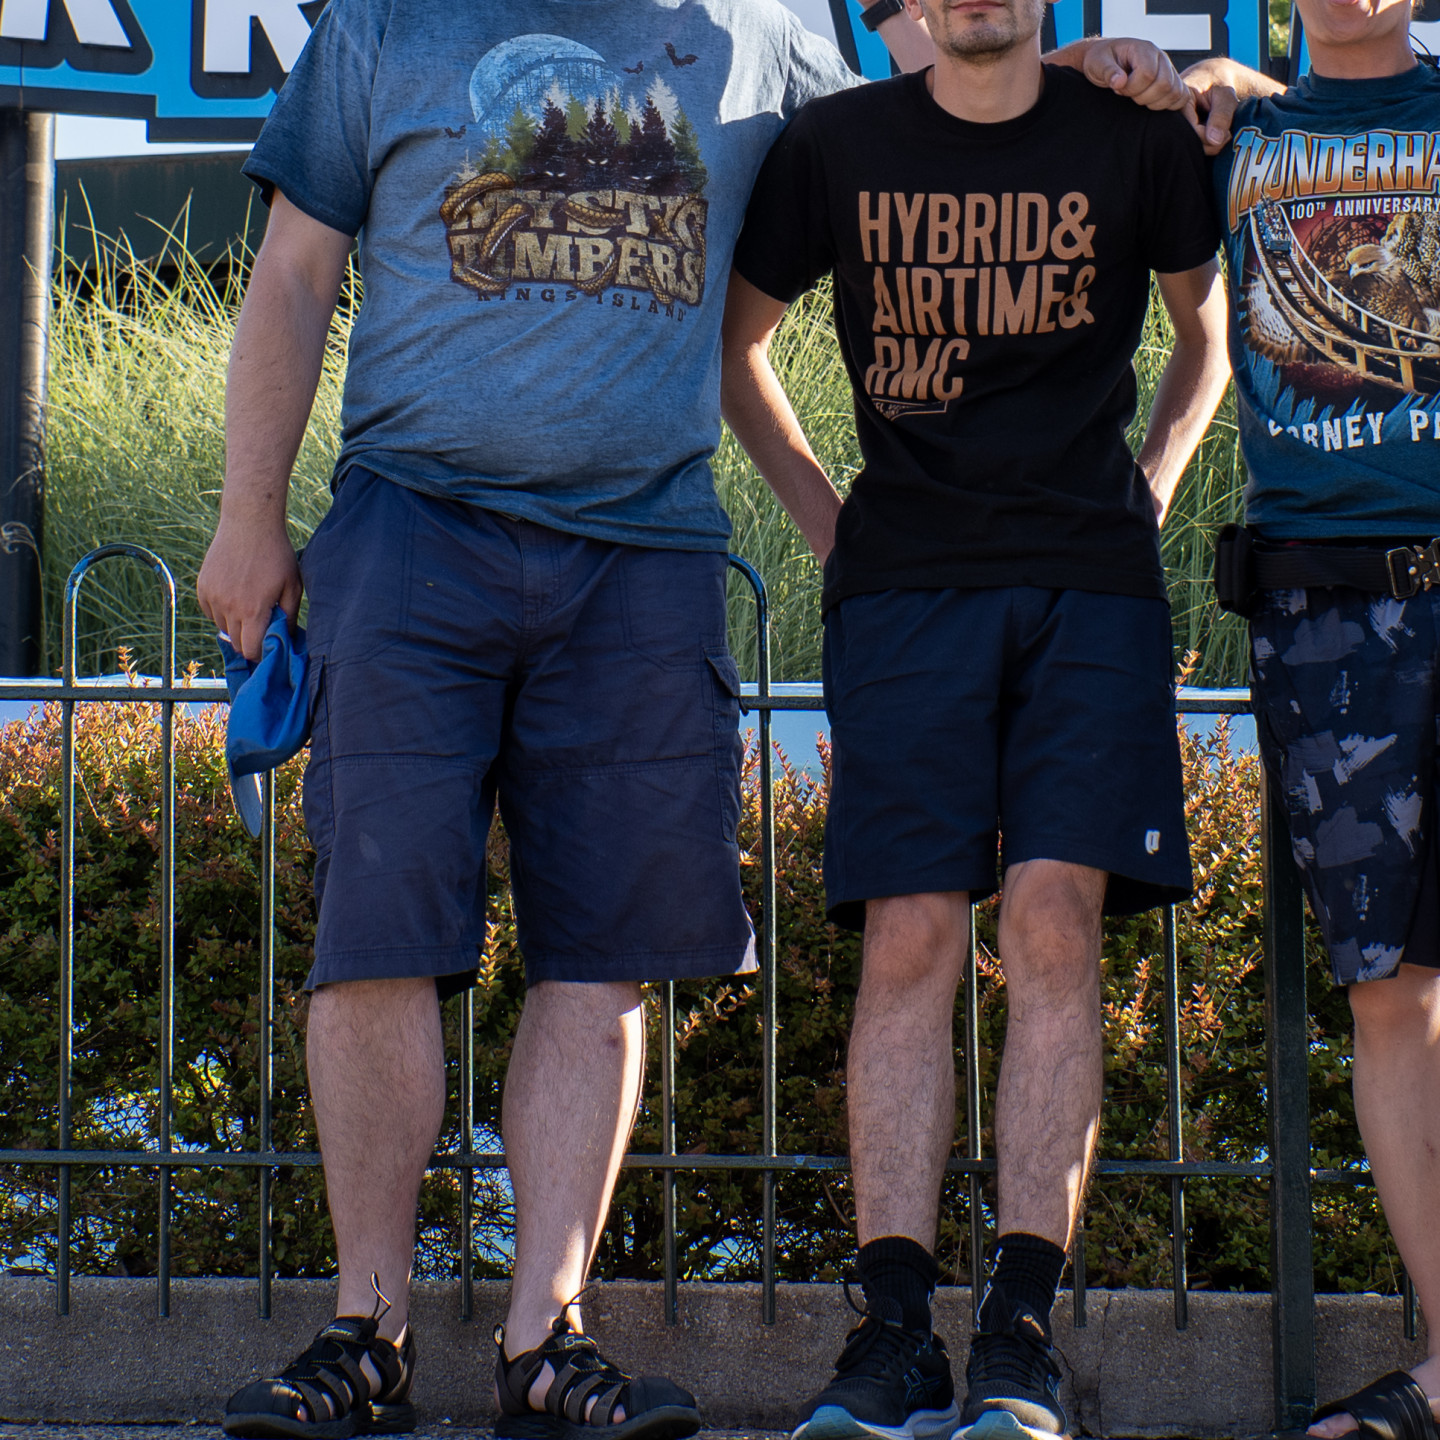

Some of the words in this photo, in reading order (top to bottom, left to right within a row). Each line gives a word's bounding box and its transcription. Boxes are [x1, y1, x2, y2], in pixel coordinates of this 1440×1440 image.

[476, 287, 578, 303] KINGS
[596, 291, 685, 322] ISLAND
[864, 335, 971, 401] RMC
